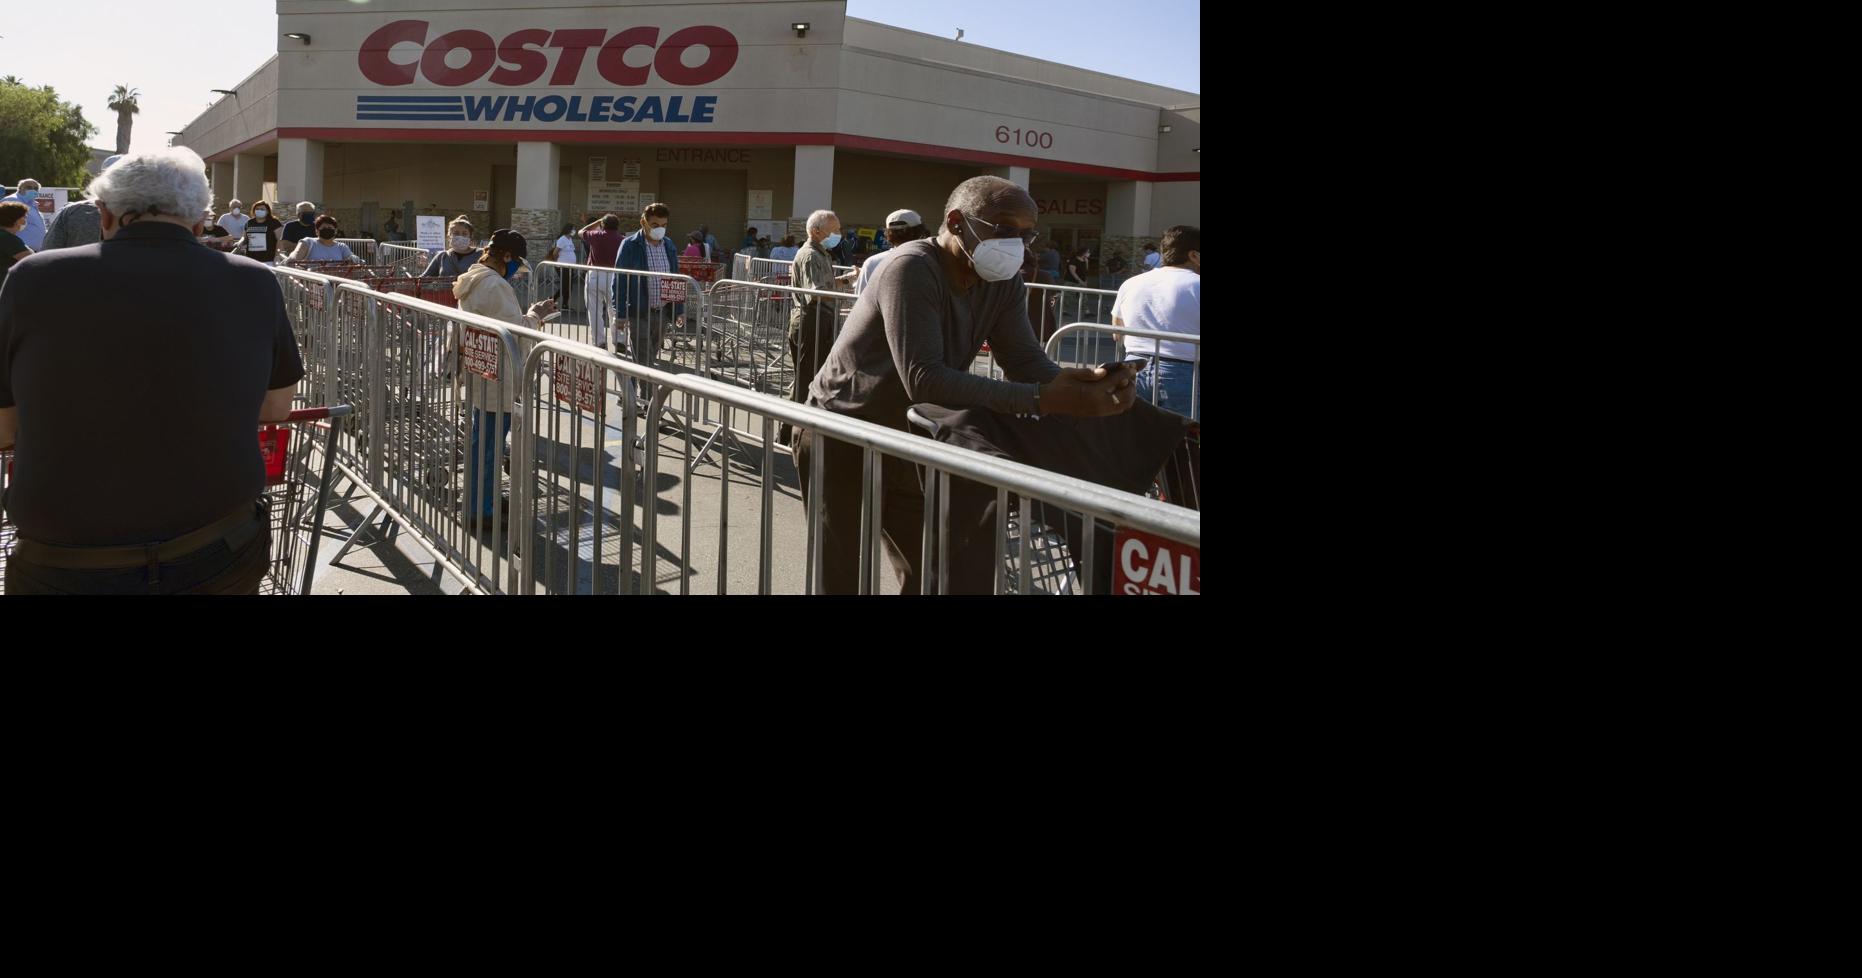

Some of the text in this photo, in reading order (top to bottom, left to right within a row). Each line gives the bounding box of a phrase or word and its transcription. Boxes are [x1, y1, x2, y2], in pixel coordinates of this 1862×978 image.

[358, 19, 739, 86] COSTCO
[462, 95, 718, 123] WHOLESALE
[995, 125, 1054, 149] 6100
[656, 147, 751, 163] ENTRANCE
[1036, 199, 1104, 215] SALES
[465, 330, 498, 355] CAL-STATE
[557, 372, 570, 385] SITE
[1121, 538, 1200, 595] CAL
